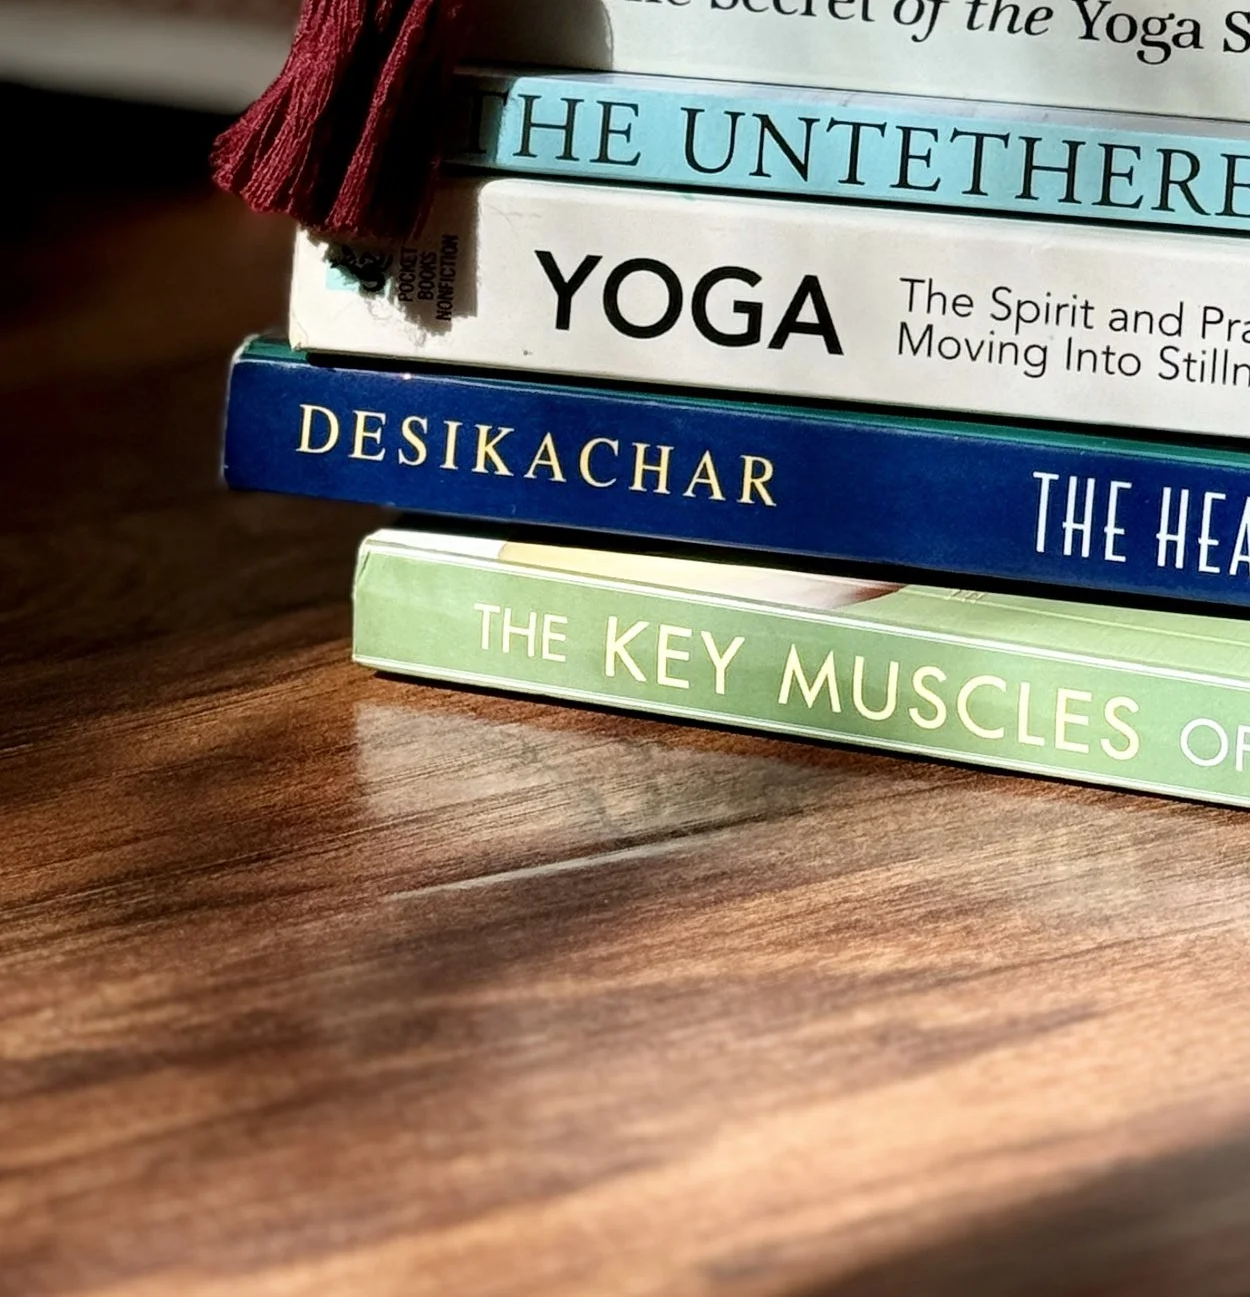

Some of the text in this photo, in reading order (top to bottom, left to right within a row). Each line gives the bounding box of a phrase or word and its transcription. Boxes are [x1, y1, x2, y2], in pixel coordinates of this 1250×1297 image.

[458, 89, 641, 166] THE
[398, 246, 418, 302] POCKET
[417, 251, 437, 301] BOOKS
[436, 234, 459, 321] NONFICTION
[534, 249, 845, 357] YOGA
[899, 276, 975, 318] The
[990, 285, 1095, 334] Spirit
[1108, 301, 1185, 338] and
[898, 321, 1048, 379] Moving
[1065, 336, 1142, 378] Into
[296, 403, 777, 507] DESIKACHAR
[1033, 471, 1133, 563] THE
[474, 602, 568, 662] THE
[604, 615, 745, 695] KEY
[777, 643, 1141, 761] MUSCLES
